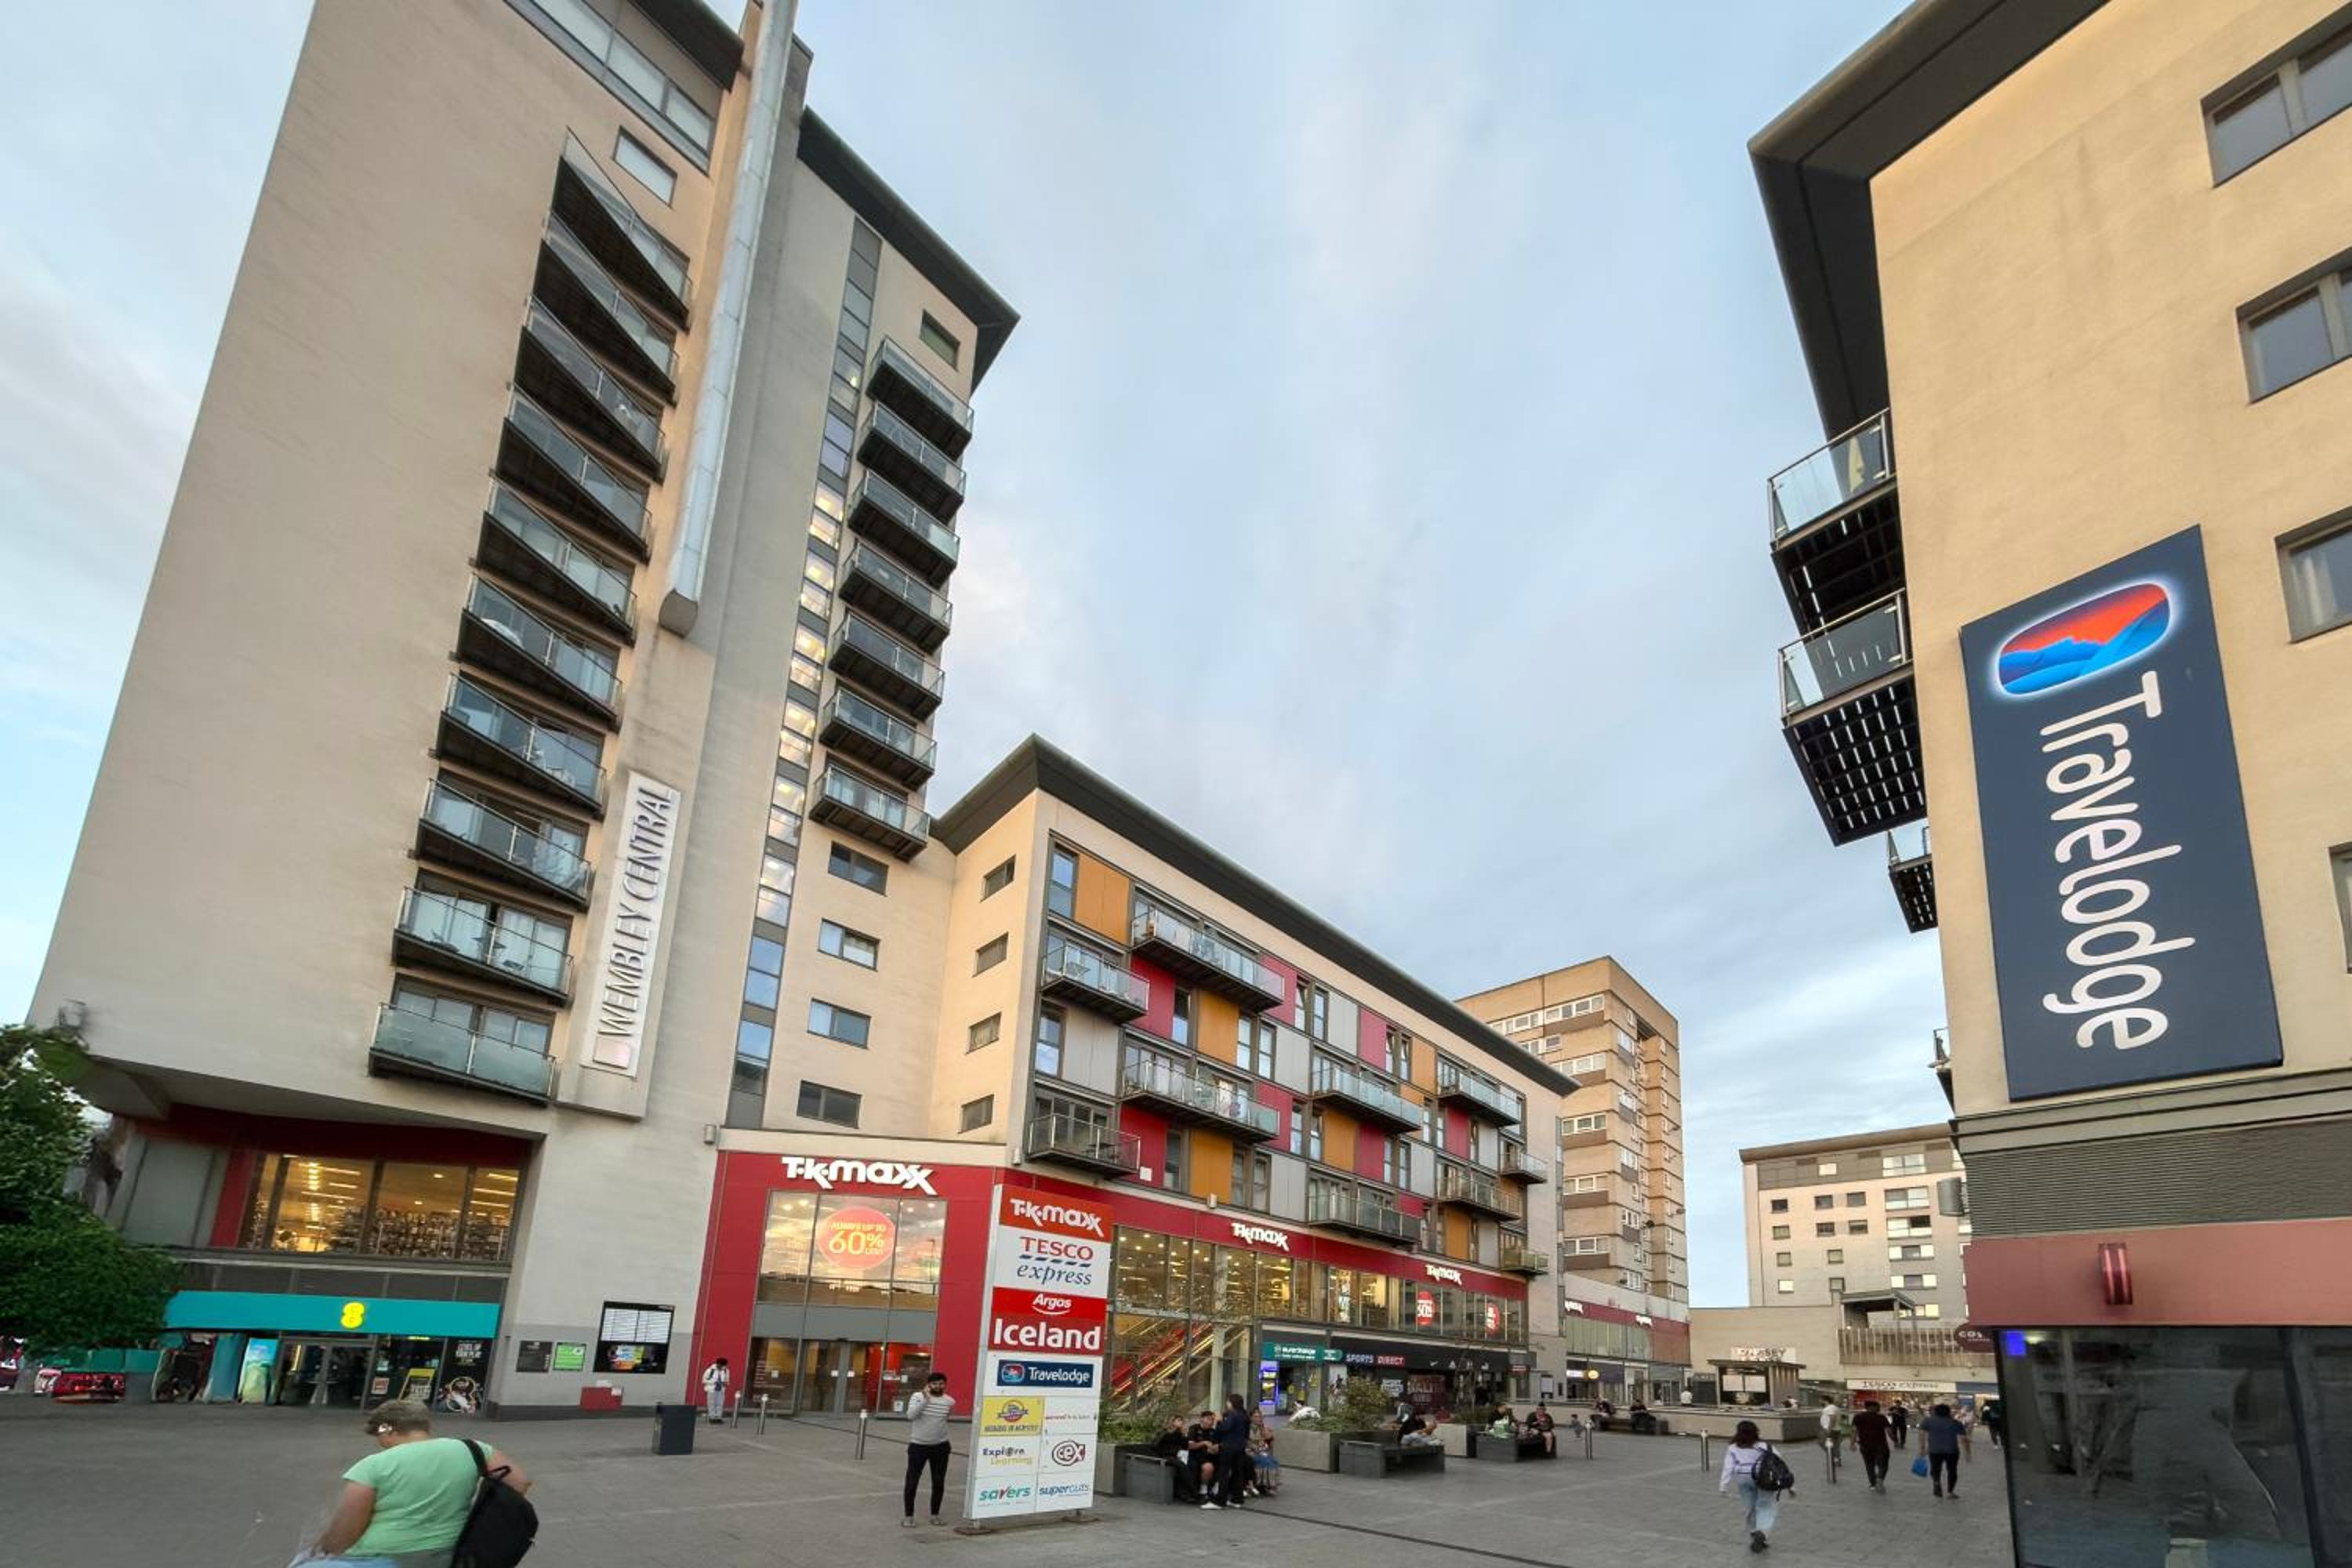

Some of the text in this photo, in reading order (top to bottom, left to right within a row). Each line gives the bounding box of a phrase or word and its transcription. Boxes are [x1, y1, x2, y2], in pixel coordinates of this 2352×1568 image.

[2039, 669, 2197, 1051] Travelodge
[597, 786, 673, 1037] WEMBLEY CENTRAL
[829, 1231, 885, 1254] 60%
[1019, 1236, 1094, 1261] TESCO
[1017, 1263, 1092, 1285] express
[1033, 1294, 1073, 1308] Argos
[993, 1318, 1102, 1350] Iceland
[1346, 1354, 1374, 1363] SPORTS
[1377, 1356, 1405, 1365] DIRECT
[1028, 1367, 1091, 1385] Travelodge
[979, 1485, 1031, 1501] savers
[1039, 1484, 1089, 1496] supercuts
